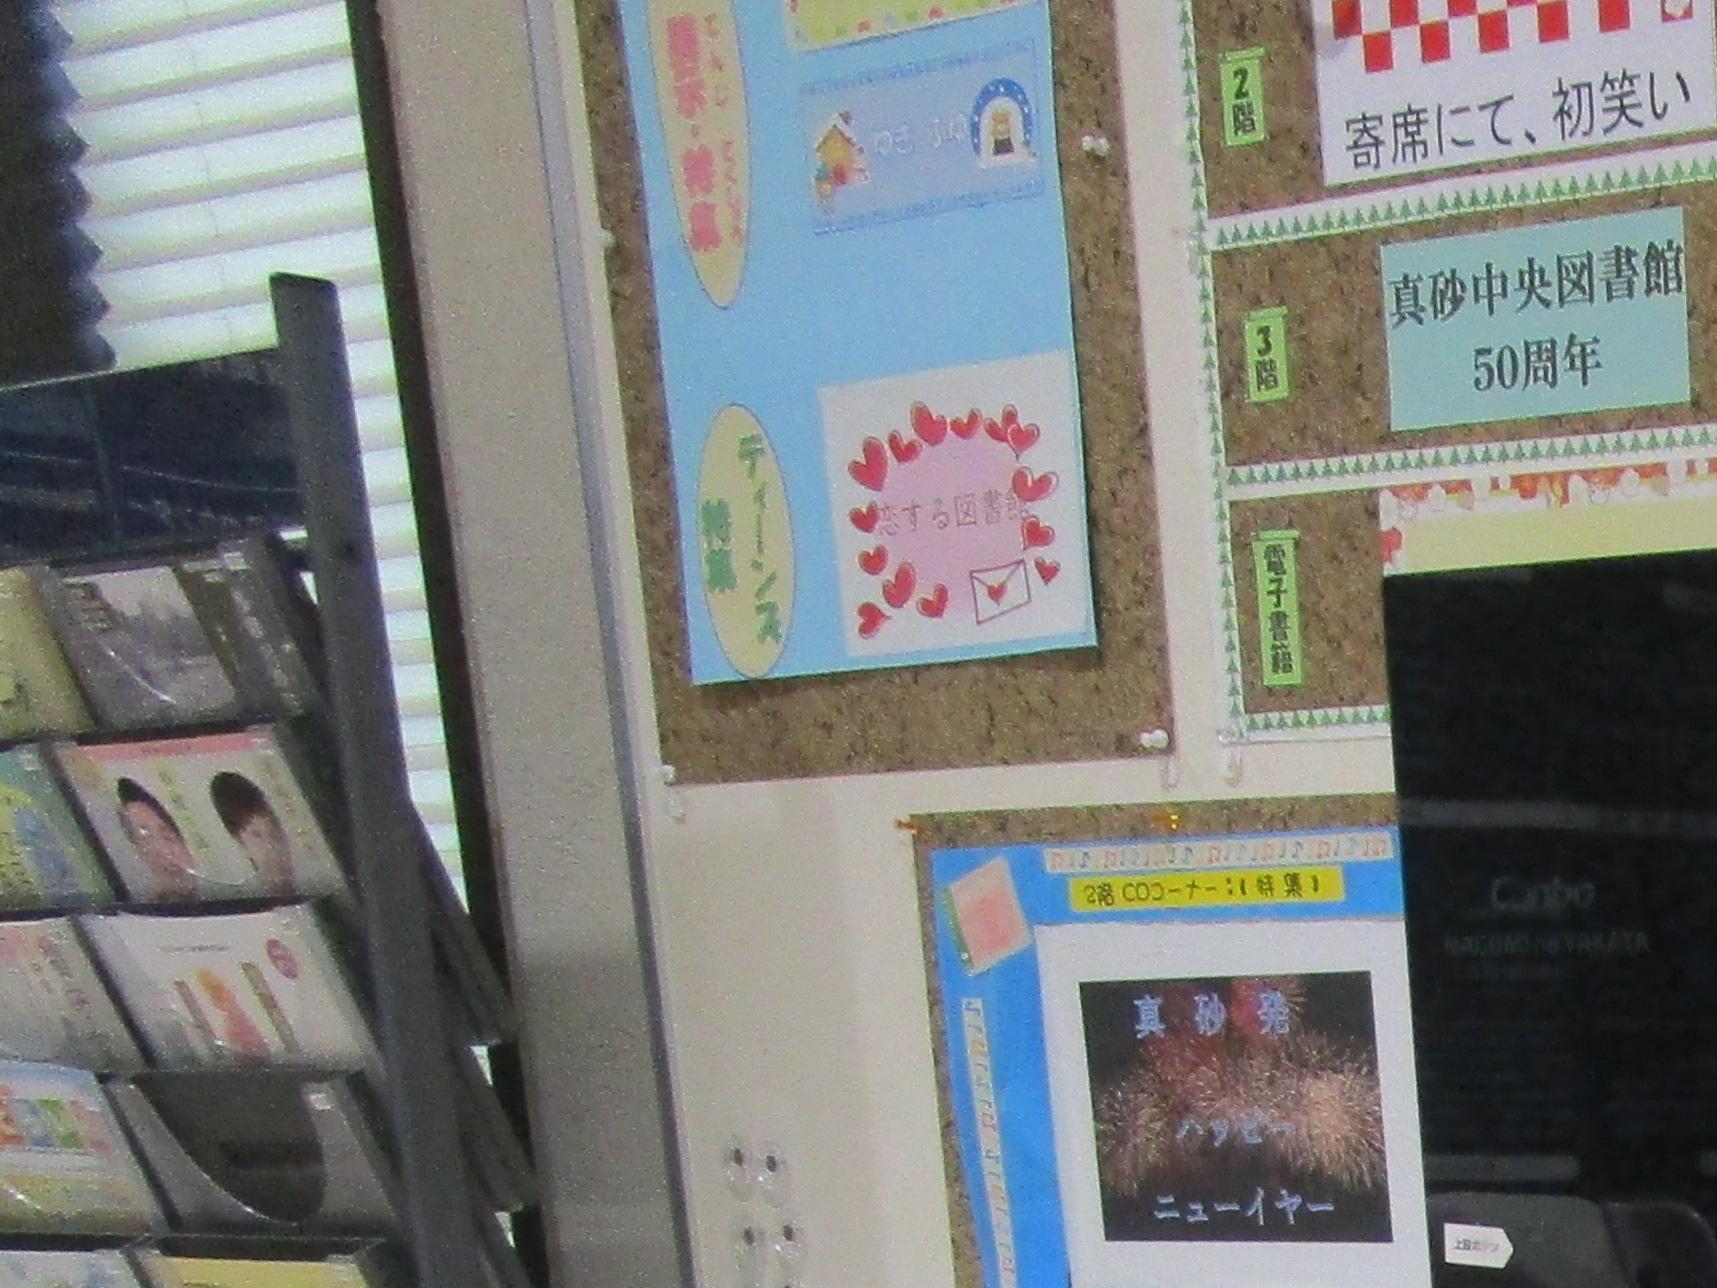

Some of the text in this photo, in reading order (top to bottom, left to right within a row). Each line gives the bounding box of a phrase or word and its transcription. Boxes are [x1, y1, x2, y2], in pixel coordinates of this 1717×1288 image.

[1232, 66, 1256, 135] 2階
[1344, 69, 1691, 171] 寄席にて、初笑い
[1387, 239, 1685, 328] 真砂中央図書館
[1255, 327, 1278, 394] 3階
[1473, 333, 1603, 393] 50周年
[1154, 1187, 1334, 1226] ニューイヤー
